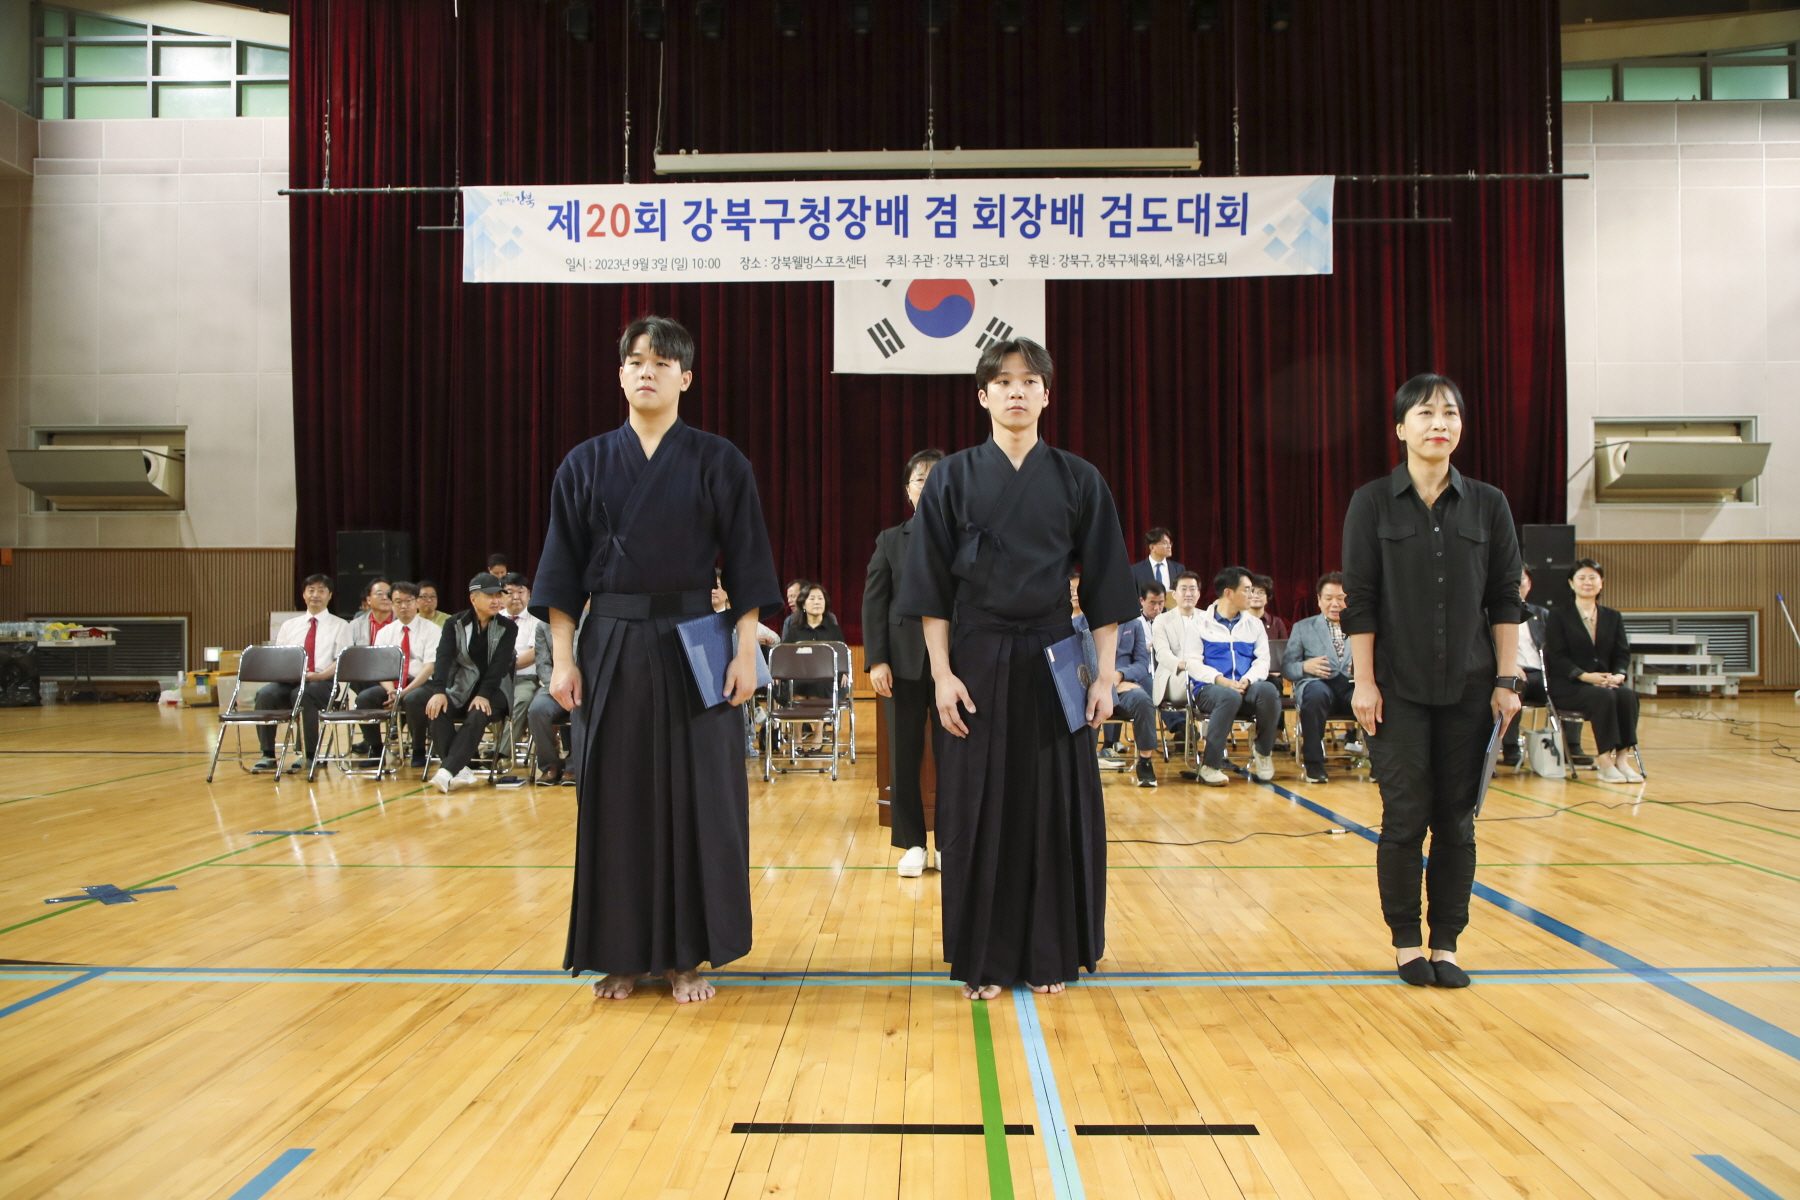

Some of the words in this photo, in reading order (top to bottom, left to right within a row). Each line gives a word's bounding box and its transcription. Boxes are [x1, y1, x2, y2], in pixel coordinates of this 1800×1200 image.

[547, 199, 667, 244] 제20회
[682, 194, 909, 243] 강북구청장배
[925, 193, 957, 239] 겸
[973, 192, 1085, 240] 회장배
[1100, 191, 1249, 239] 검도대회
[565, 257, 586, 273] 일시
[594, 257, 630, 272] 2023년
[632, 257, 649, 272] 9월
[651, 257, 668, 272] 3일
[671, 257, 688, 272] (일)
[692, 257, 721, 270] 10:00
[739, 256, 762, 271] 장소
[770, 254, 867, 271] 강북웰빙스포츠센터
[943, 253, 976, 269] 강북구
[978, 253, 1009, 269] 검도회
[1027, 253, 1049, 269] 후원
[1058, 253, 1094, 269] 강북구,
[1095, 252, 1163, 269] 강북구체육회,
[1164, 251, 1228, 268] 서울시검도회
